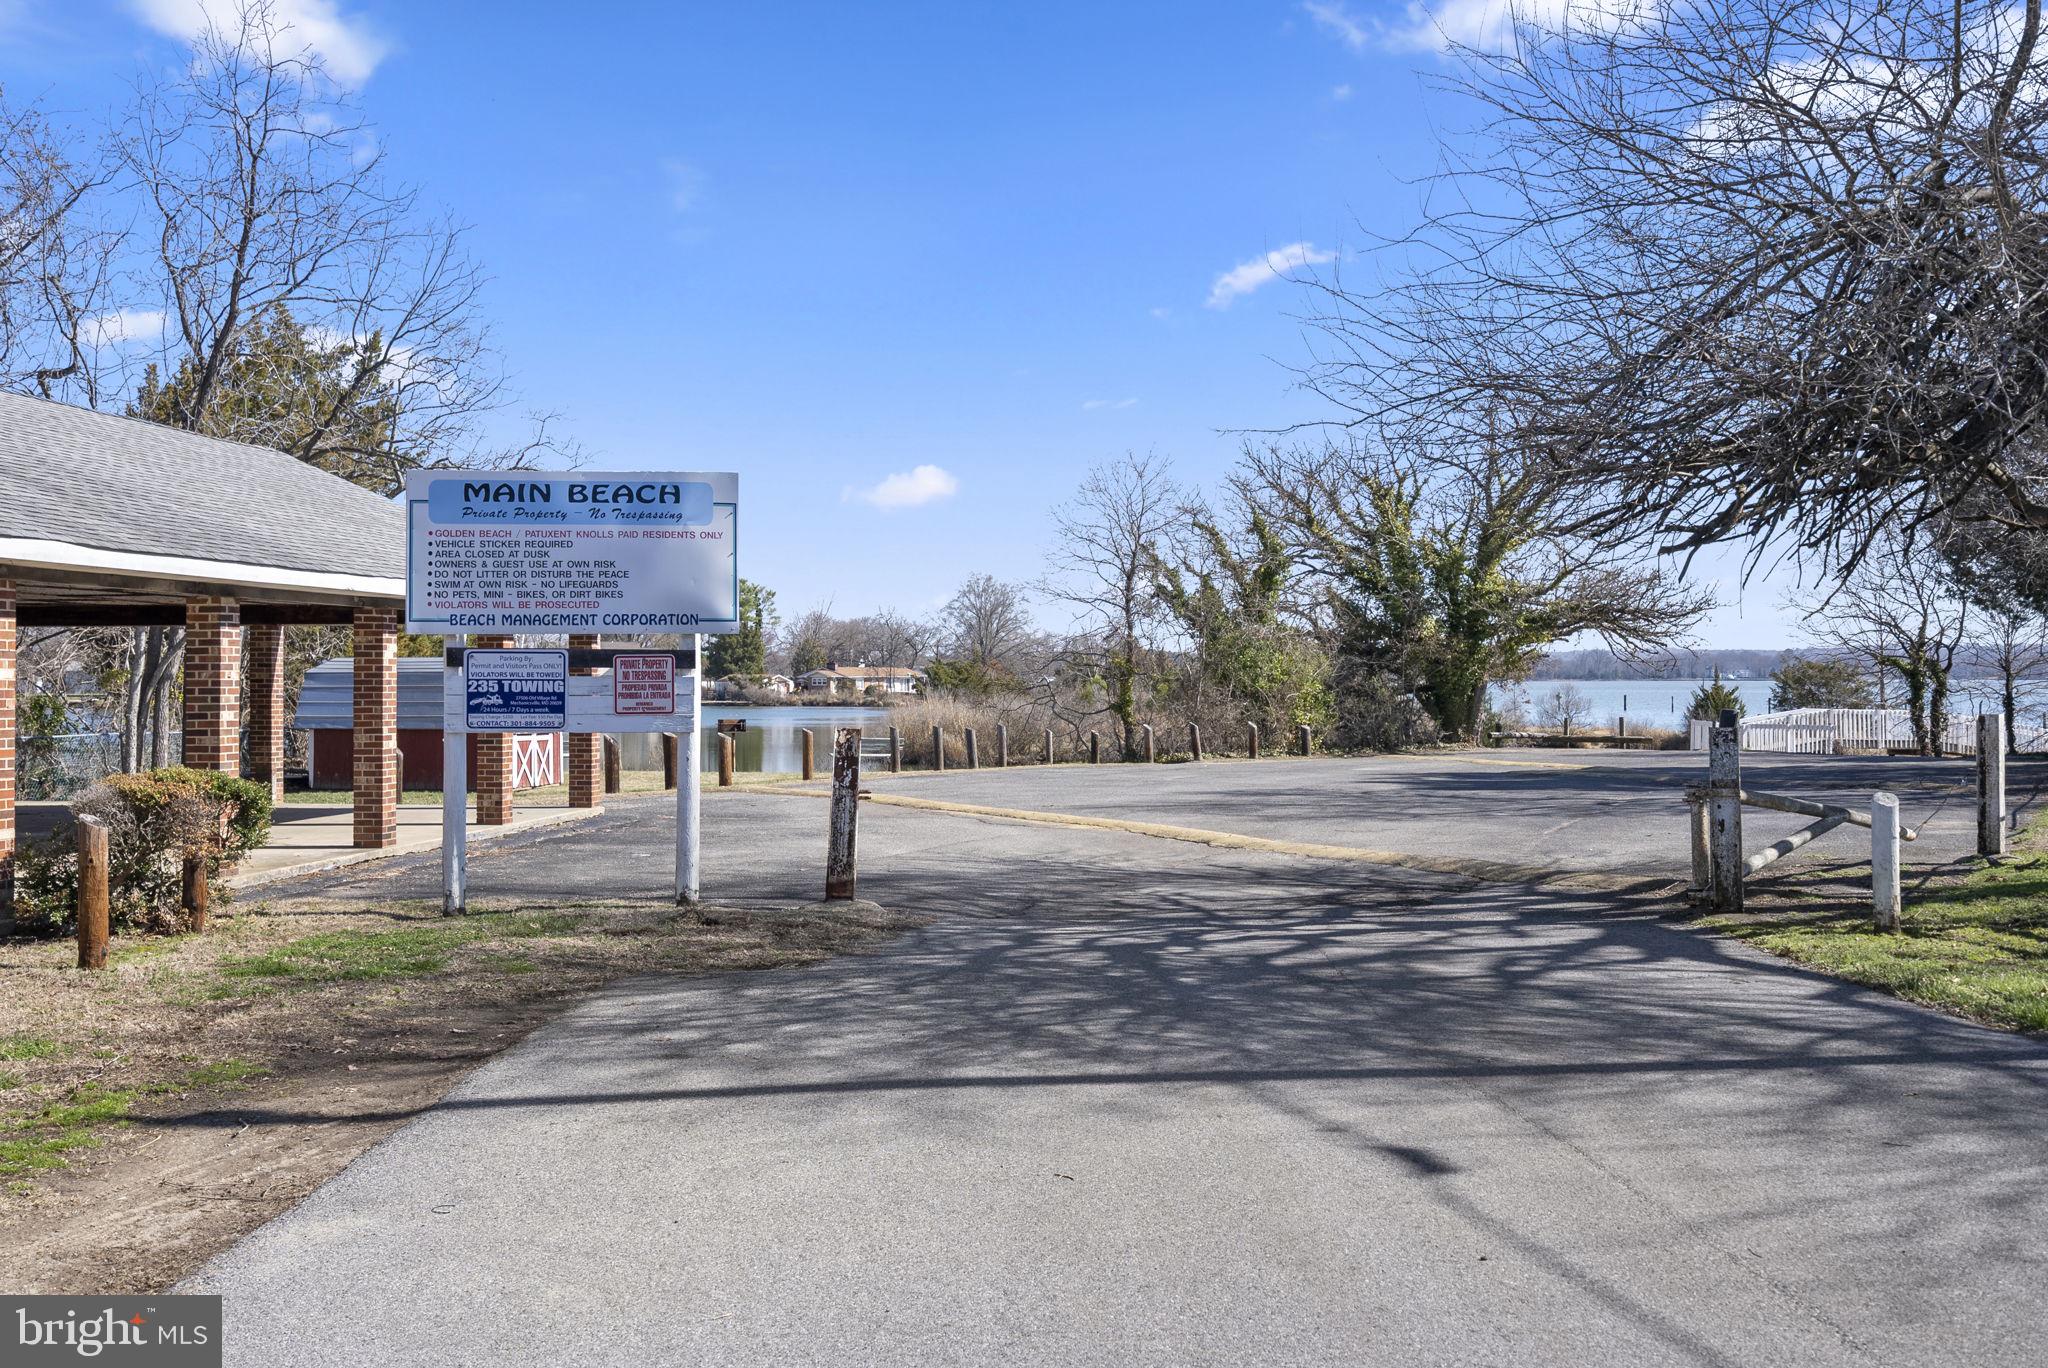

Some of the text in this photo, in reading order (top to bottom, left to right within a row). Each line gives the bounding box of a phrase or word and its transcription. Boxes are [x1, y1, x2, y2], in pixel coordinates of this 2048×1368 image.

[464, 483, 680, 504] MAIN BEACH
[462, 506, 508, 518] Private
[514, 507, 568, 521] Property
[588, 507, 606, 520] No
[612, 508, 684, 522] Trespassing
[435, 529, 724, 540] GOLDEN BEACH / PATUXENT KNOLLS PAID RESIDENTS ONLY
[434, 540, 574, 548] VEHICLE STICKER REQUIRED
[434, 550, 550, 558] AREA CLOSED AT DUSK
[434, 560, 616, 568] OWNERS & GUEST USE AT OWN RISK
[434, 570, 630, 578] DO NOT LITTER OR DISTURB THE PEACE
[434, 580, 460, 588] SWIM
[464, 580, 474, 588] AT
[478, 580, 502, 588] OWN
[506, 580, 528, 588] RISK
[540, 580, 556, 588] NO
[560, 580, 618, 588] LIFEGUARDS
[434, 590, 448, 598] NO
[452, 590, 480, 600] PETS,
[484, 590, 504, 598] MINI
[517, 590, 548, 600] BIKES,
[552, 590, 566, 598] OR
[570, 590, 592, 598] DIRT
[596, 590, 624, 598] BIKES
[434, 600, 600, 609] VIOLATORS WILL BE PROSECUTED
[450, 614, 699, 626] BEACH MANAGEMENT CORPORATION
[620, 659, 668, 669] PRIVATE PROPERTY
[622, 670, 666, 680] NO TRESPASSING
[468, 680, 564, 692] 235 TOWING
